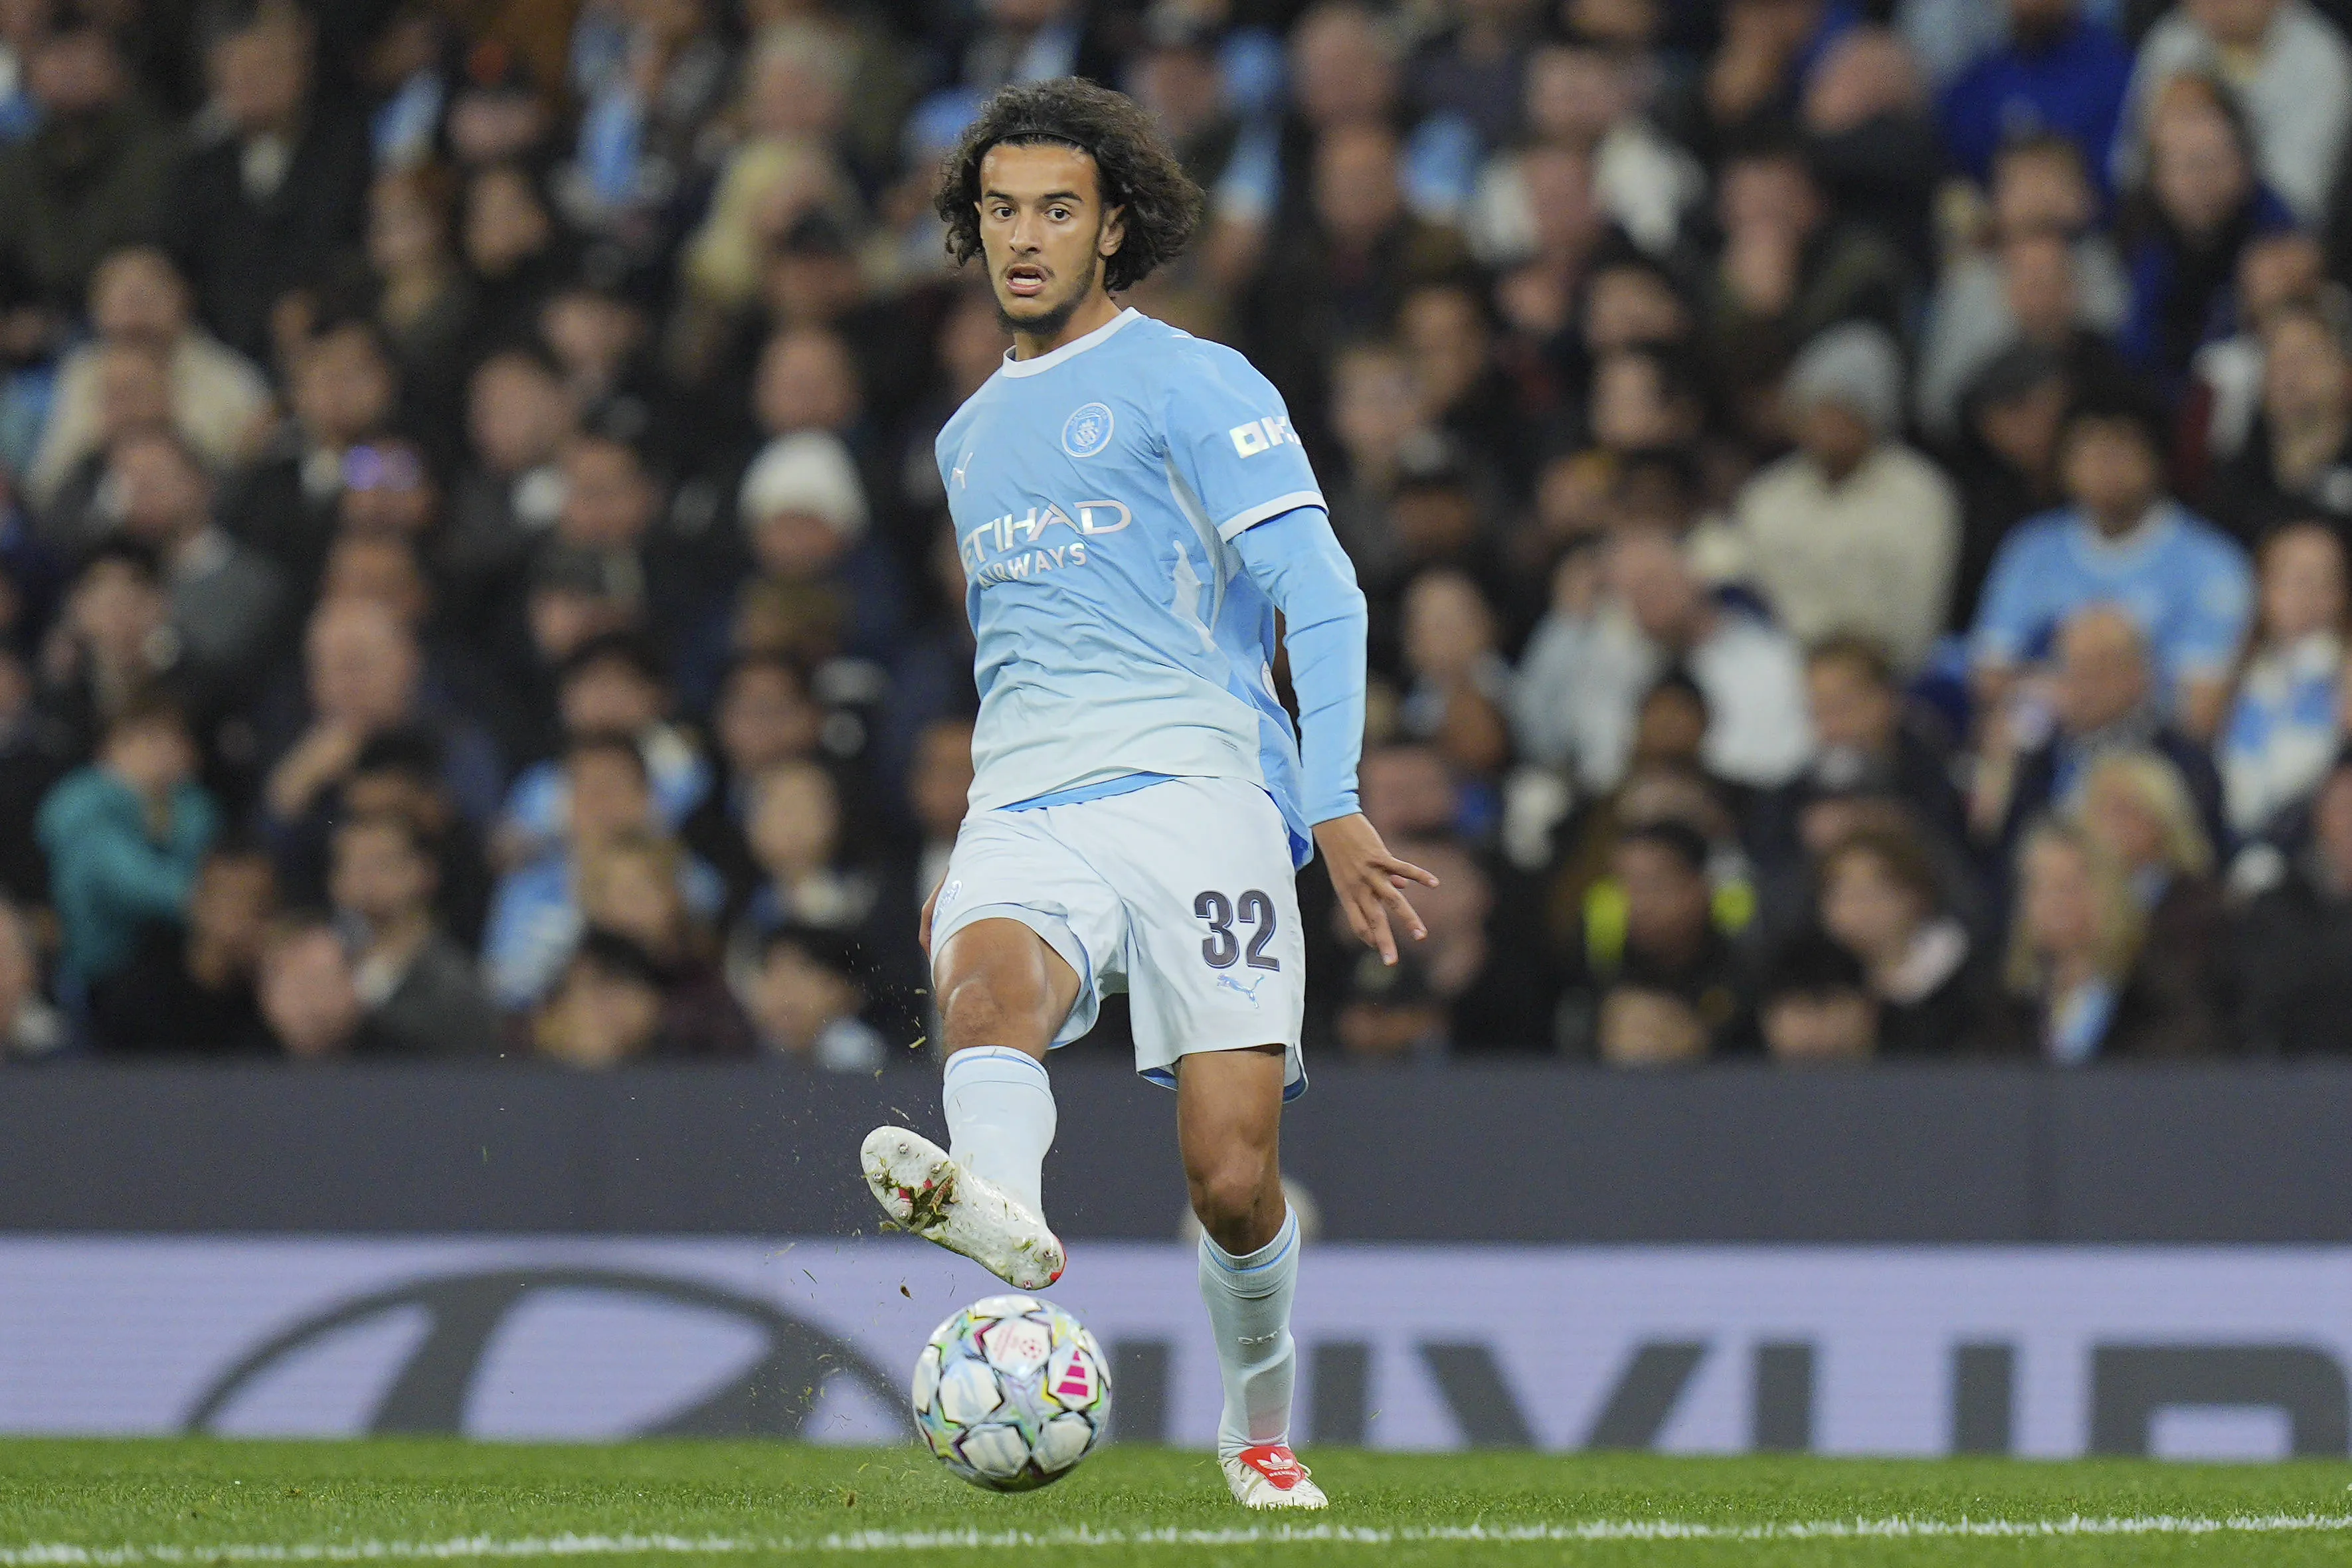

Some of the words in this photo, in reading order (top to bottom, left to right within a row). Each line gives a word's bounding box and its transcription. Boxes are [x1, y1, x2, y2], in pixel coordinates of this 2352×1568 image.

[1229, 416, 1301, 459] OK
[961, 500, 1132, 575] ETIHAD
[1194, 889, 1280, 972] 32
